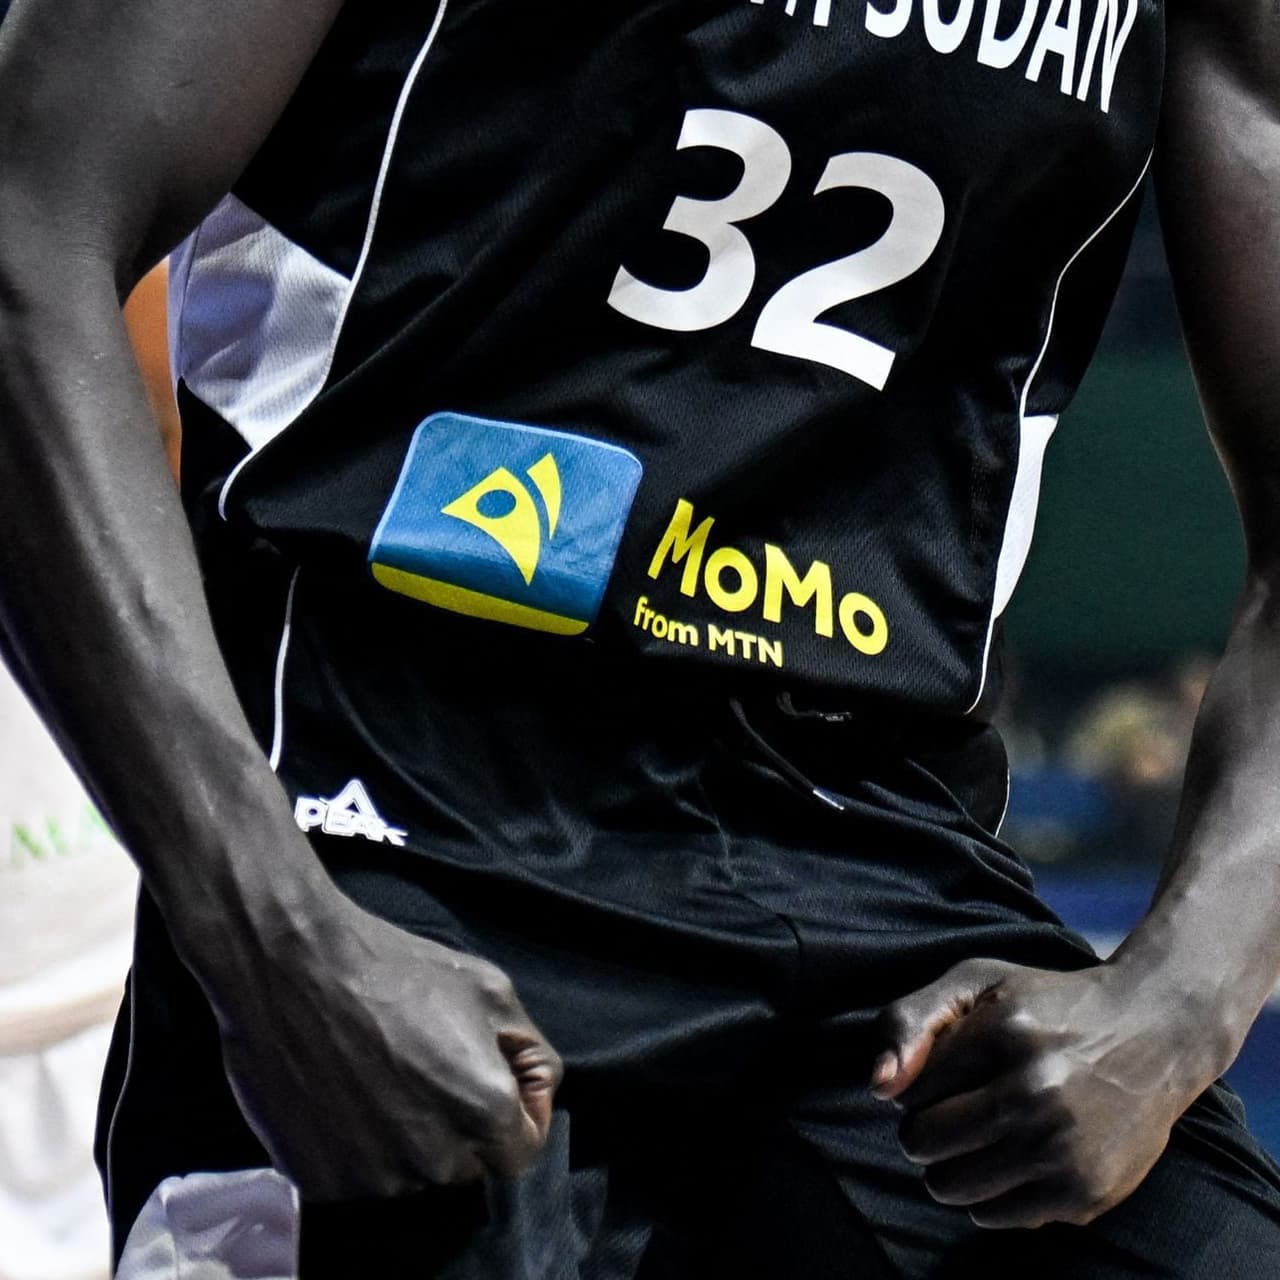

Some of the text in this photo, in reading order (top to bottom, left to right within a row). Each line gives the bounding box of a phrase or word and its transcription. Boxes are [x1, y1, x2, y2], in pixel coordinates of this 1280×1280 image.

[607, 108, 945, 391] 32
[632, 595, 784, 668] from MTN
[647, 497, 889, 656] MoMo
